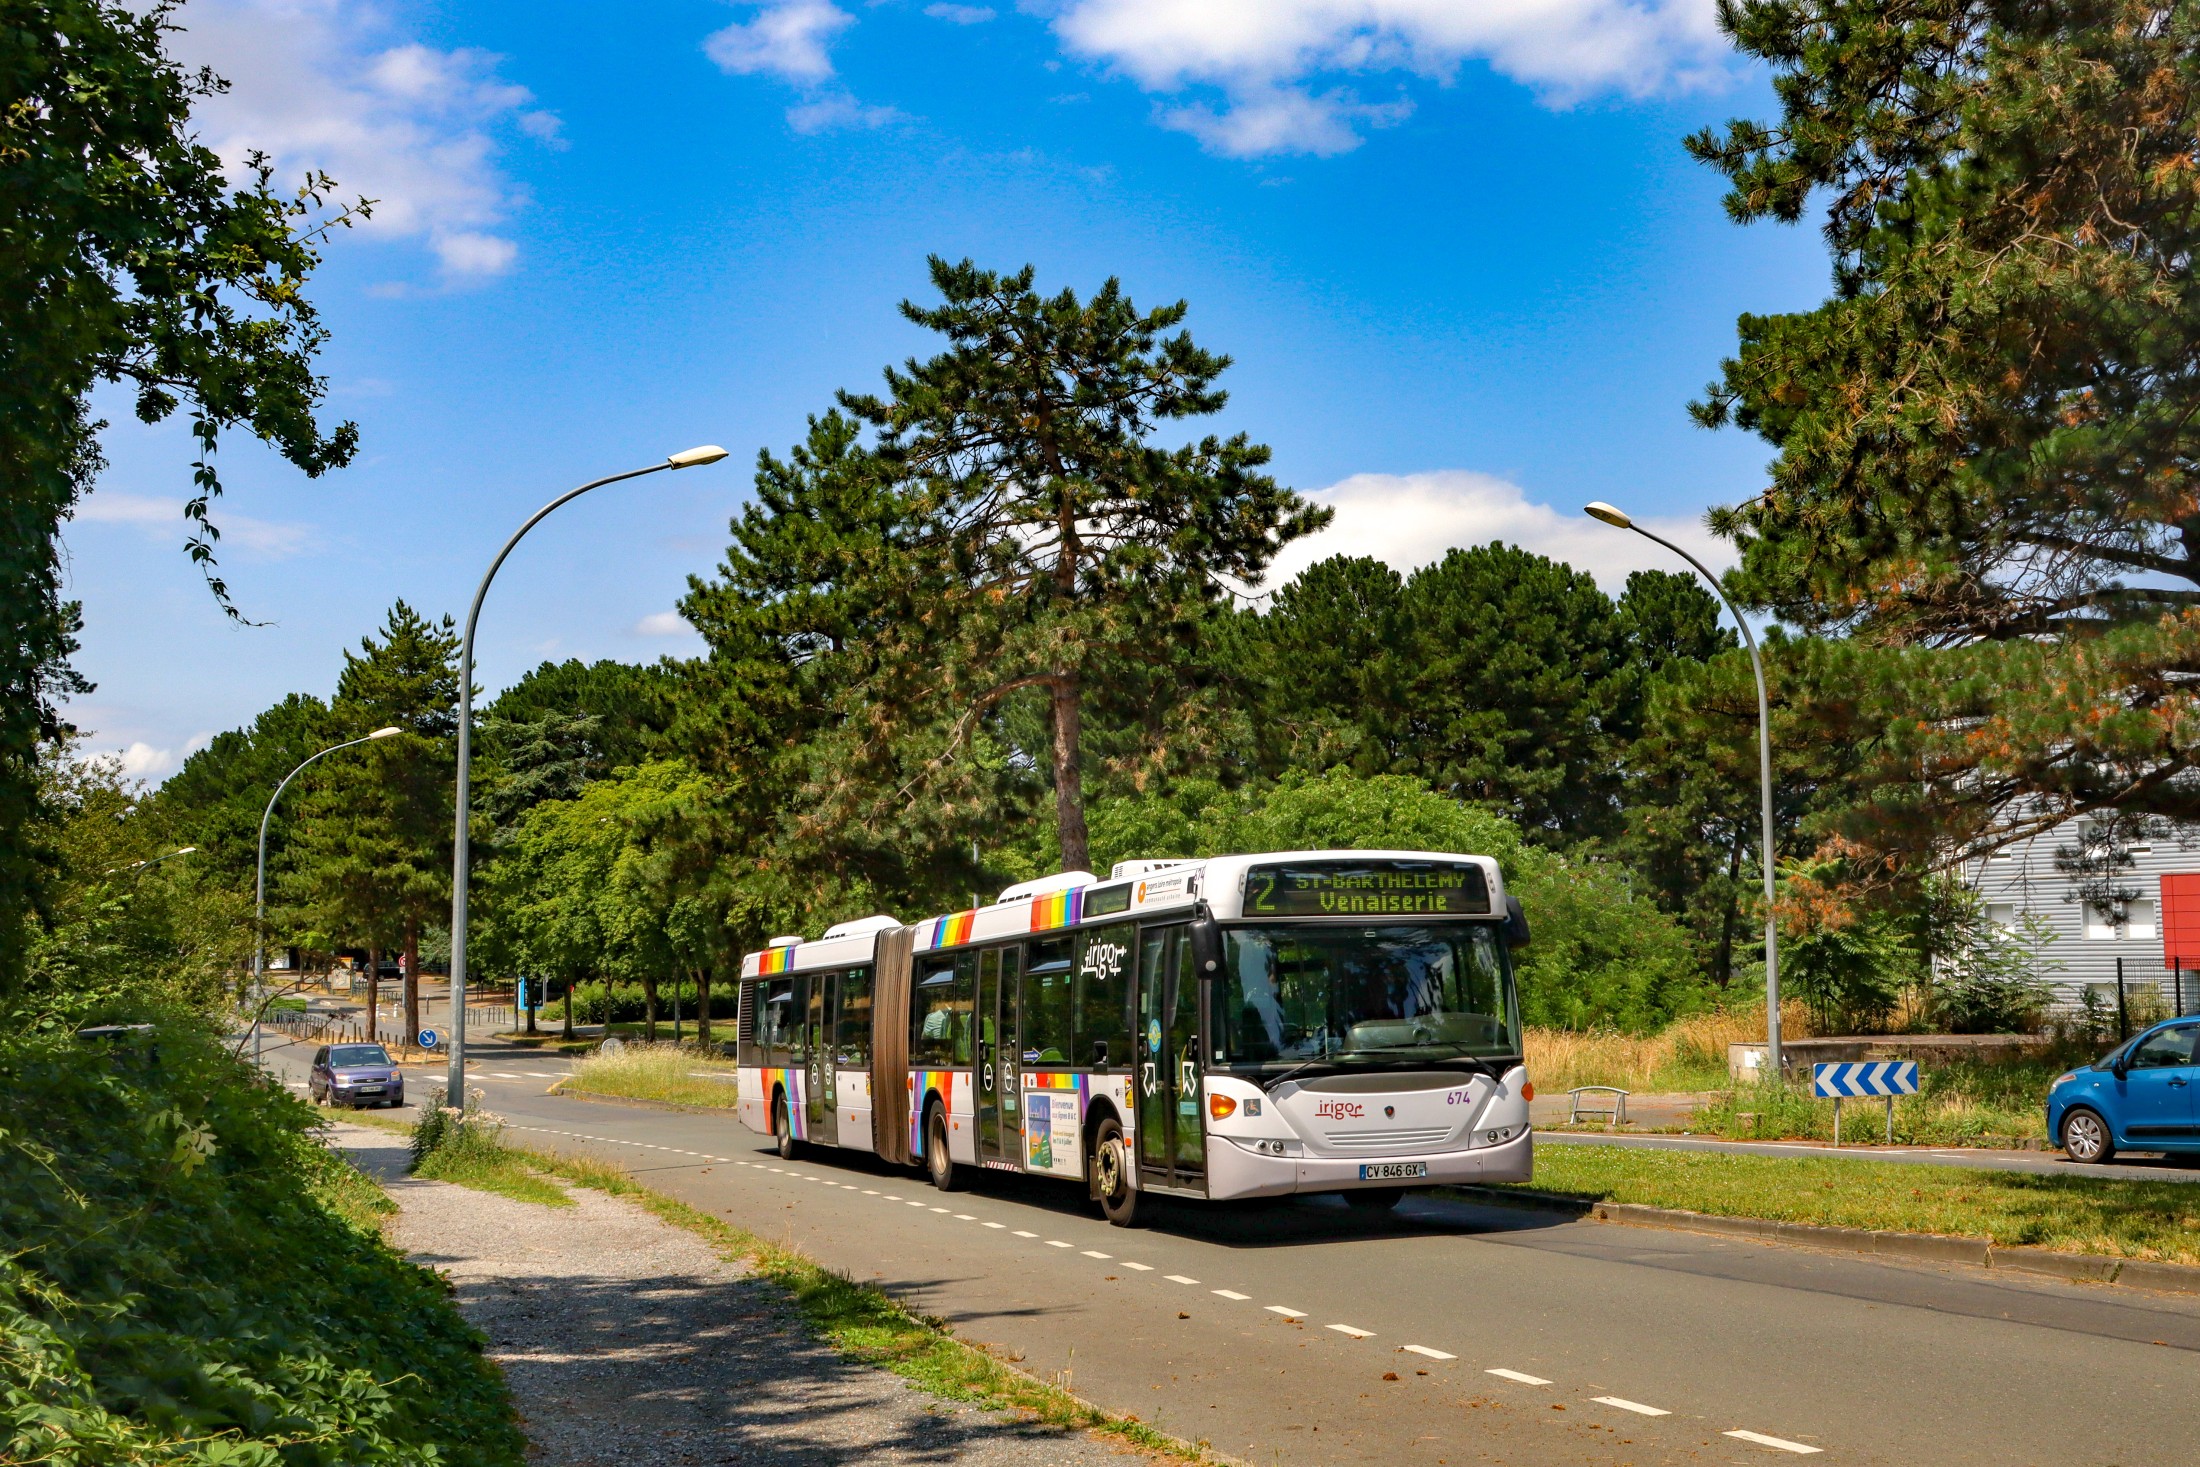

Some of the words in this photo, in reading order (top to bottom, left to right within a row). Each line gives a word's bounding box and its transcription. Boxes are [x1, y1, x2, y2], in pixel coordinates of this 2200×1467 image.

[1254, 872, 1275, 911] 2
[1295, 872, 1466, 889] ST-BARTHELEMY
[1319, 890, 1447, 912] Venaiserie
[1446, 1091, 1471, 1105] 674
